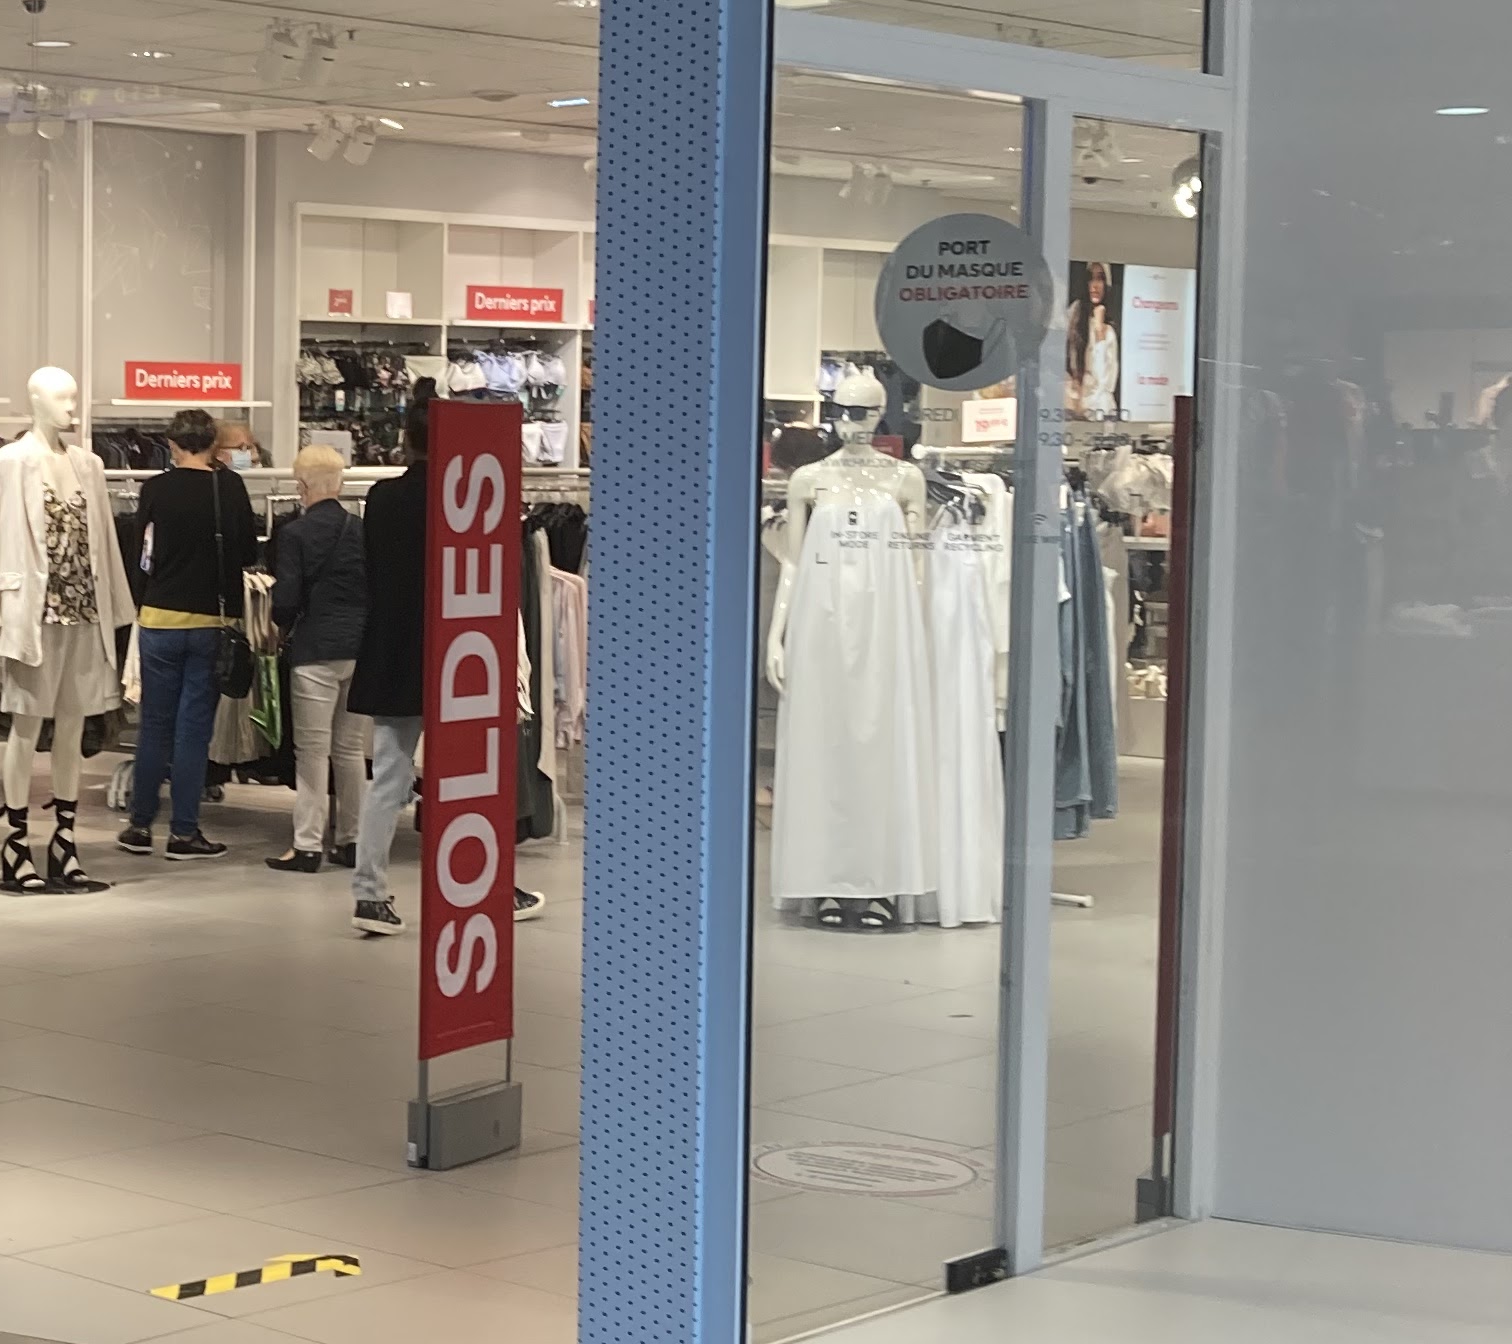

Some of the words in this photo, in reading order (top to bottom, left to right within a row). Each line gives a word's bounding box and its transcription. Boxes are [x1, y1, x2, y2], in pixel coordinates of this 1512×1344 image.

[938, 239, 991, 256] PORT
[906, 264, 934, 280] DU
[938, 261, 1024, 279] MASQUE
[898, 284, 1030, 302] OBLIGATOIRE
[474, 292, 529, 311] Derniers
[530, 295, 557, 315] prix
[134, 368, 201, 390] Derniers
[202, 372, 233, 393] prix
[888, 541, 935, 550] RETURNS
[435, 452, 506, 998] SOLDES
